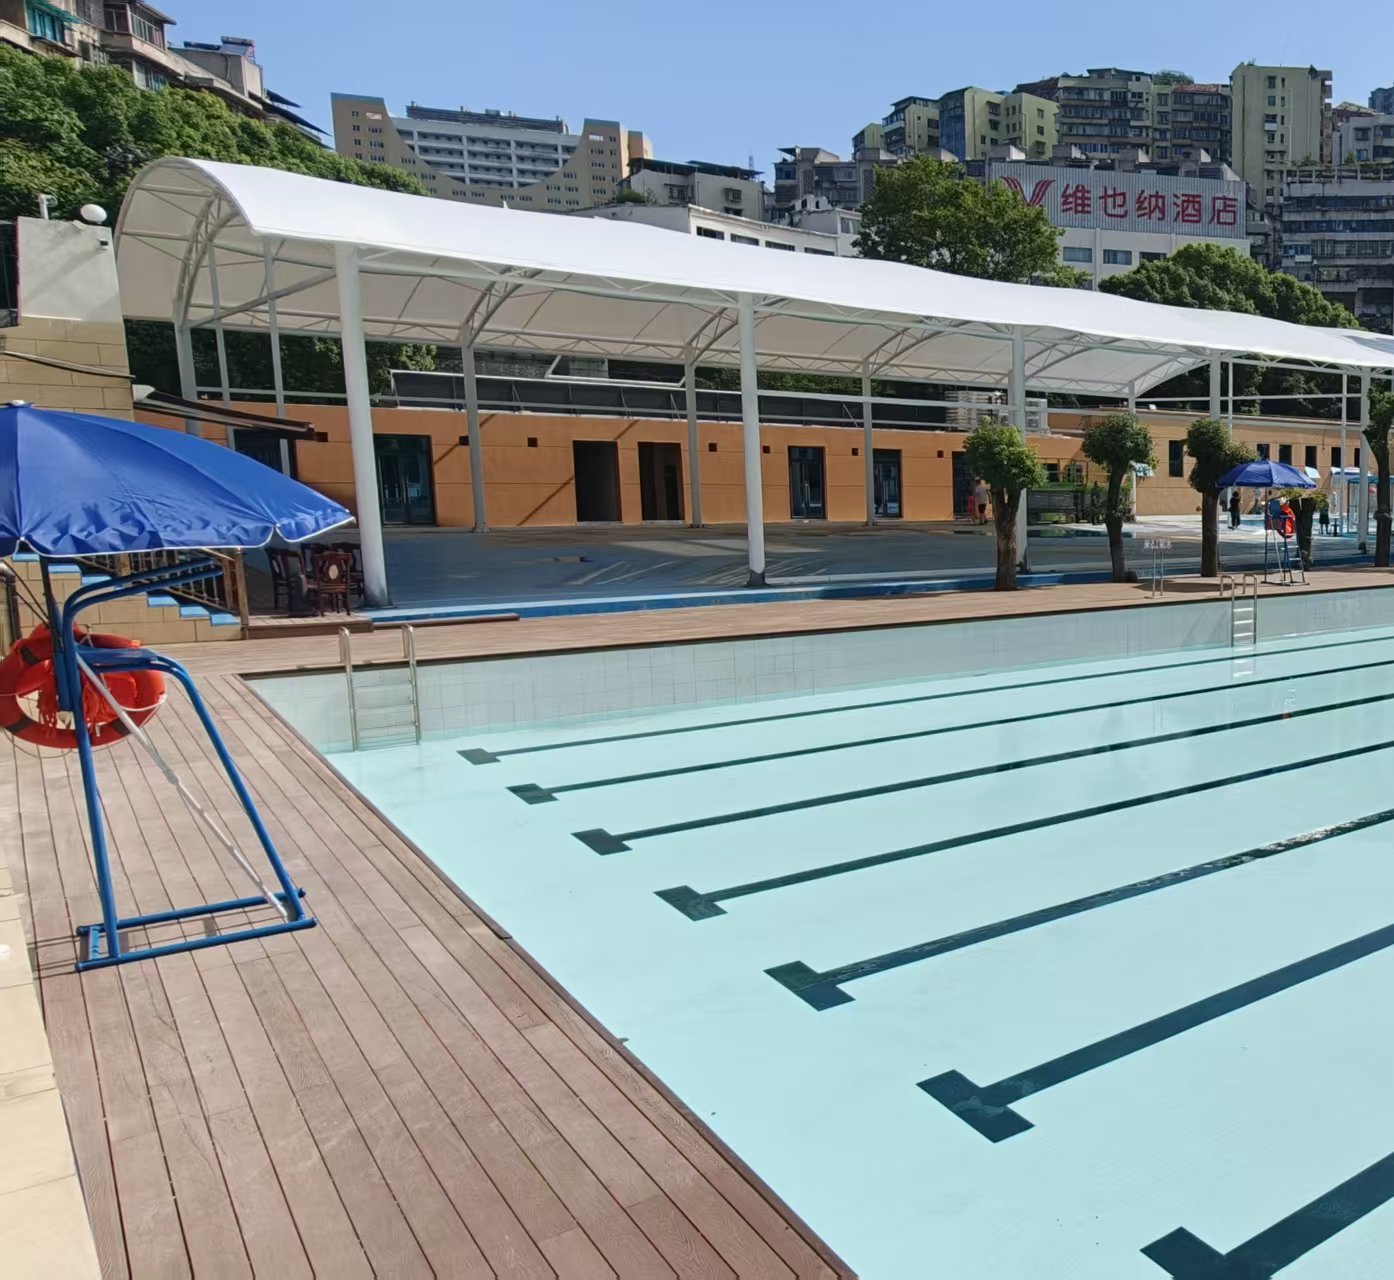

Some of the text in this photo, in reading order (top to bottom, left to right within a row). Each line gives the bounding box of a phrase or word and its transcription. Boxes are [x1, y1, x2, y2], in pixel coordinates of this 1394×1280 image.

[1060, 184, 1238, 226] 维也纳酒店
